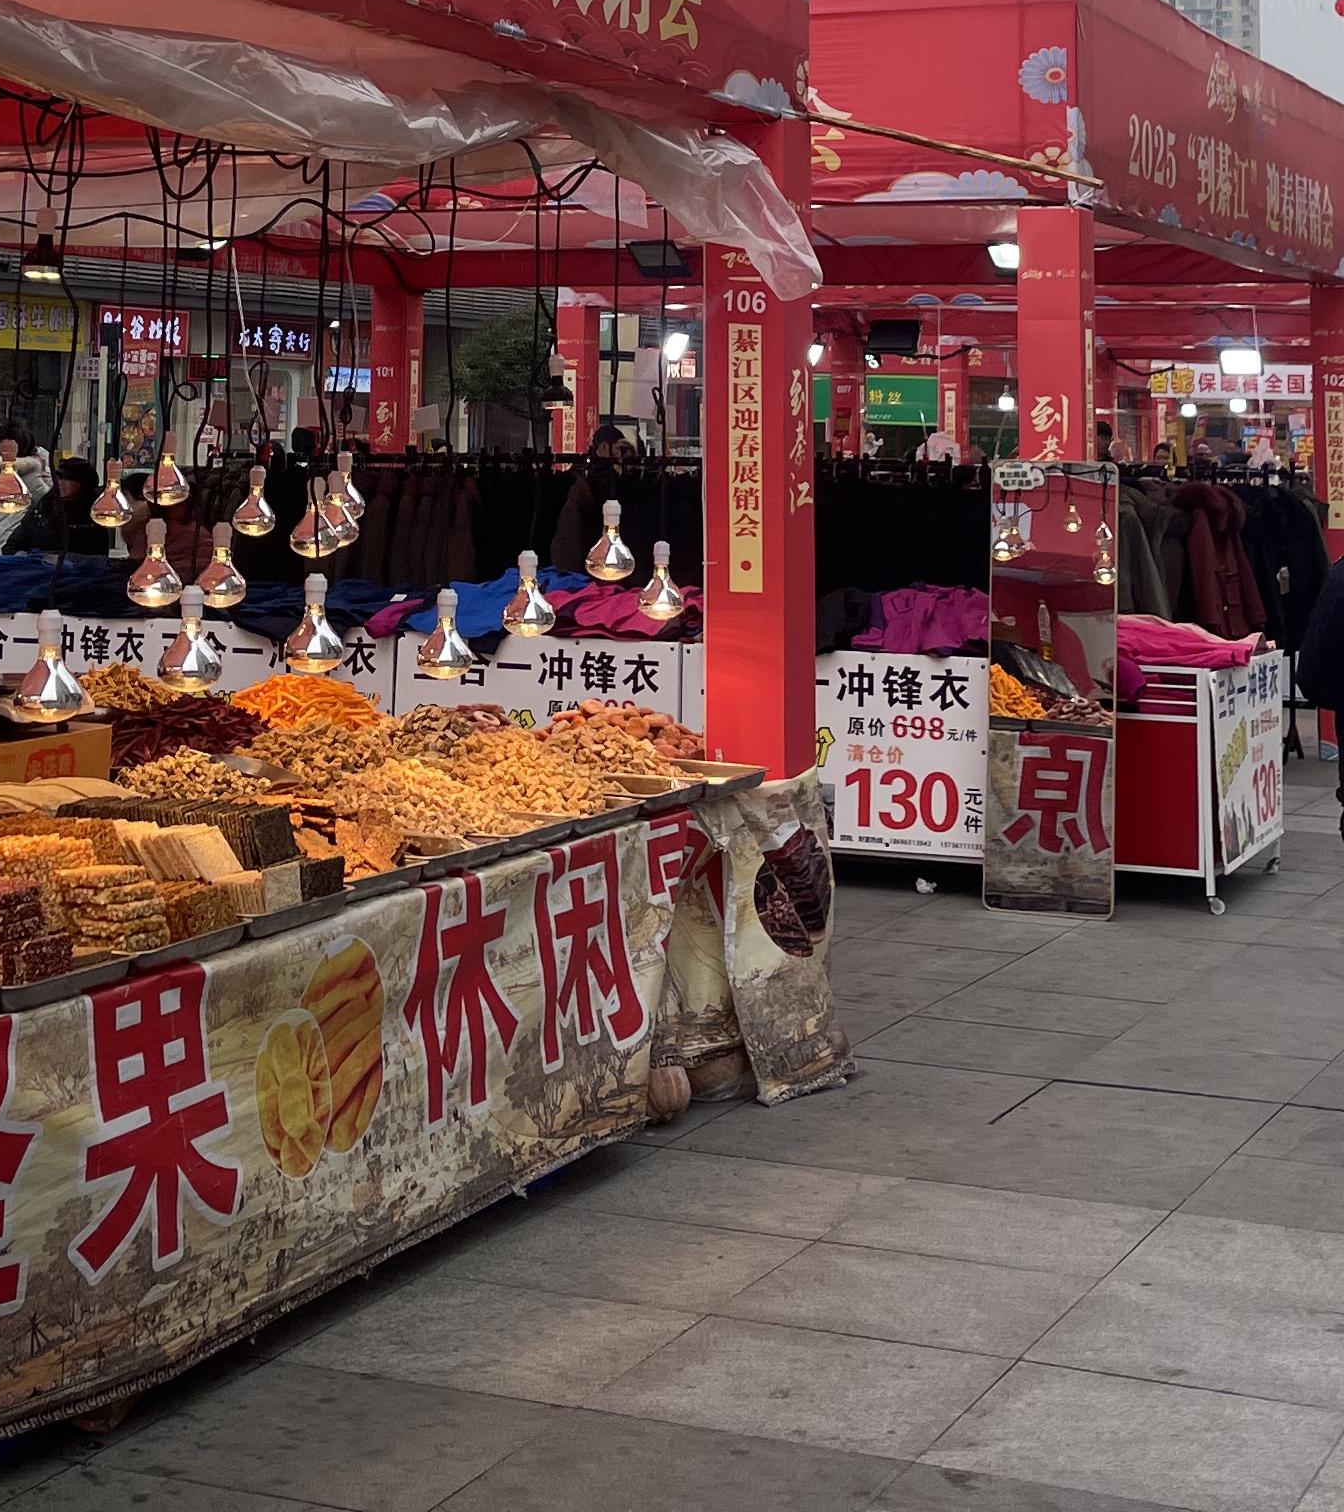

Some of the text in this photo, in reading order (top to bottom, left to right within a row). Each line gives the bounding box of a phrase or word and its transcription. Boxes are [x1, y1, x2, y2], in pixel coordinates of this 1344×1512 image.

[1128, 113, 1177, 189] 2025
[1265, 162, 1335, 250] 迎春展销会
[722, 289, 767, 315] 106
[375, 366, 394, 378] 101
[732, 329, 761, 538] 綦江区迎春展销会
[788, 367, 813, 515] 到綦江
[847, 715, 978, 742] 原价 698 元/件
[847, 744, 904, 765] 清仓价
[845, 768, 959, 833] 130
[964, 788, 983, 833] 元/件
[1253, 759, 1277, 826] 130
